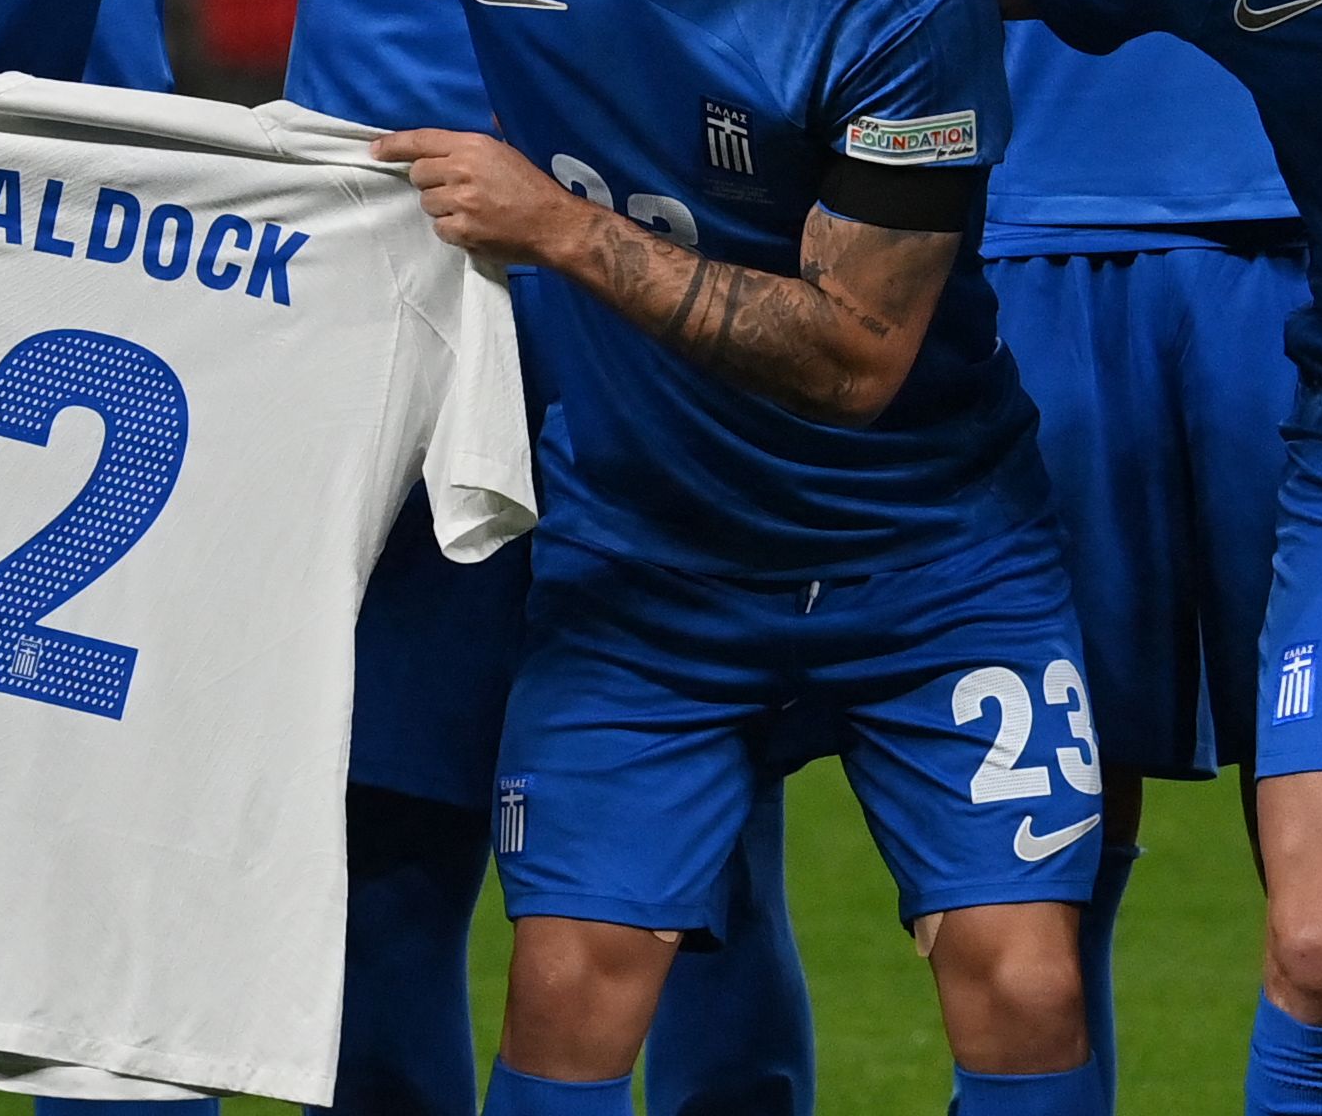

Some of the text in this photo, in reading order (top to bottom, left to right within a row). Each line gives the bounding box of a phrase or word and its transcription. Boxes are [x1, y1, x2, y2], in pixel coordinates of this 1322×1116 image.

[707, 102, 748, 124] ΕΛΛΑΣ
[851, 125, 973, 151] FOUNDATION
[951, 658, 1105, 805] 23
